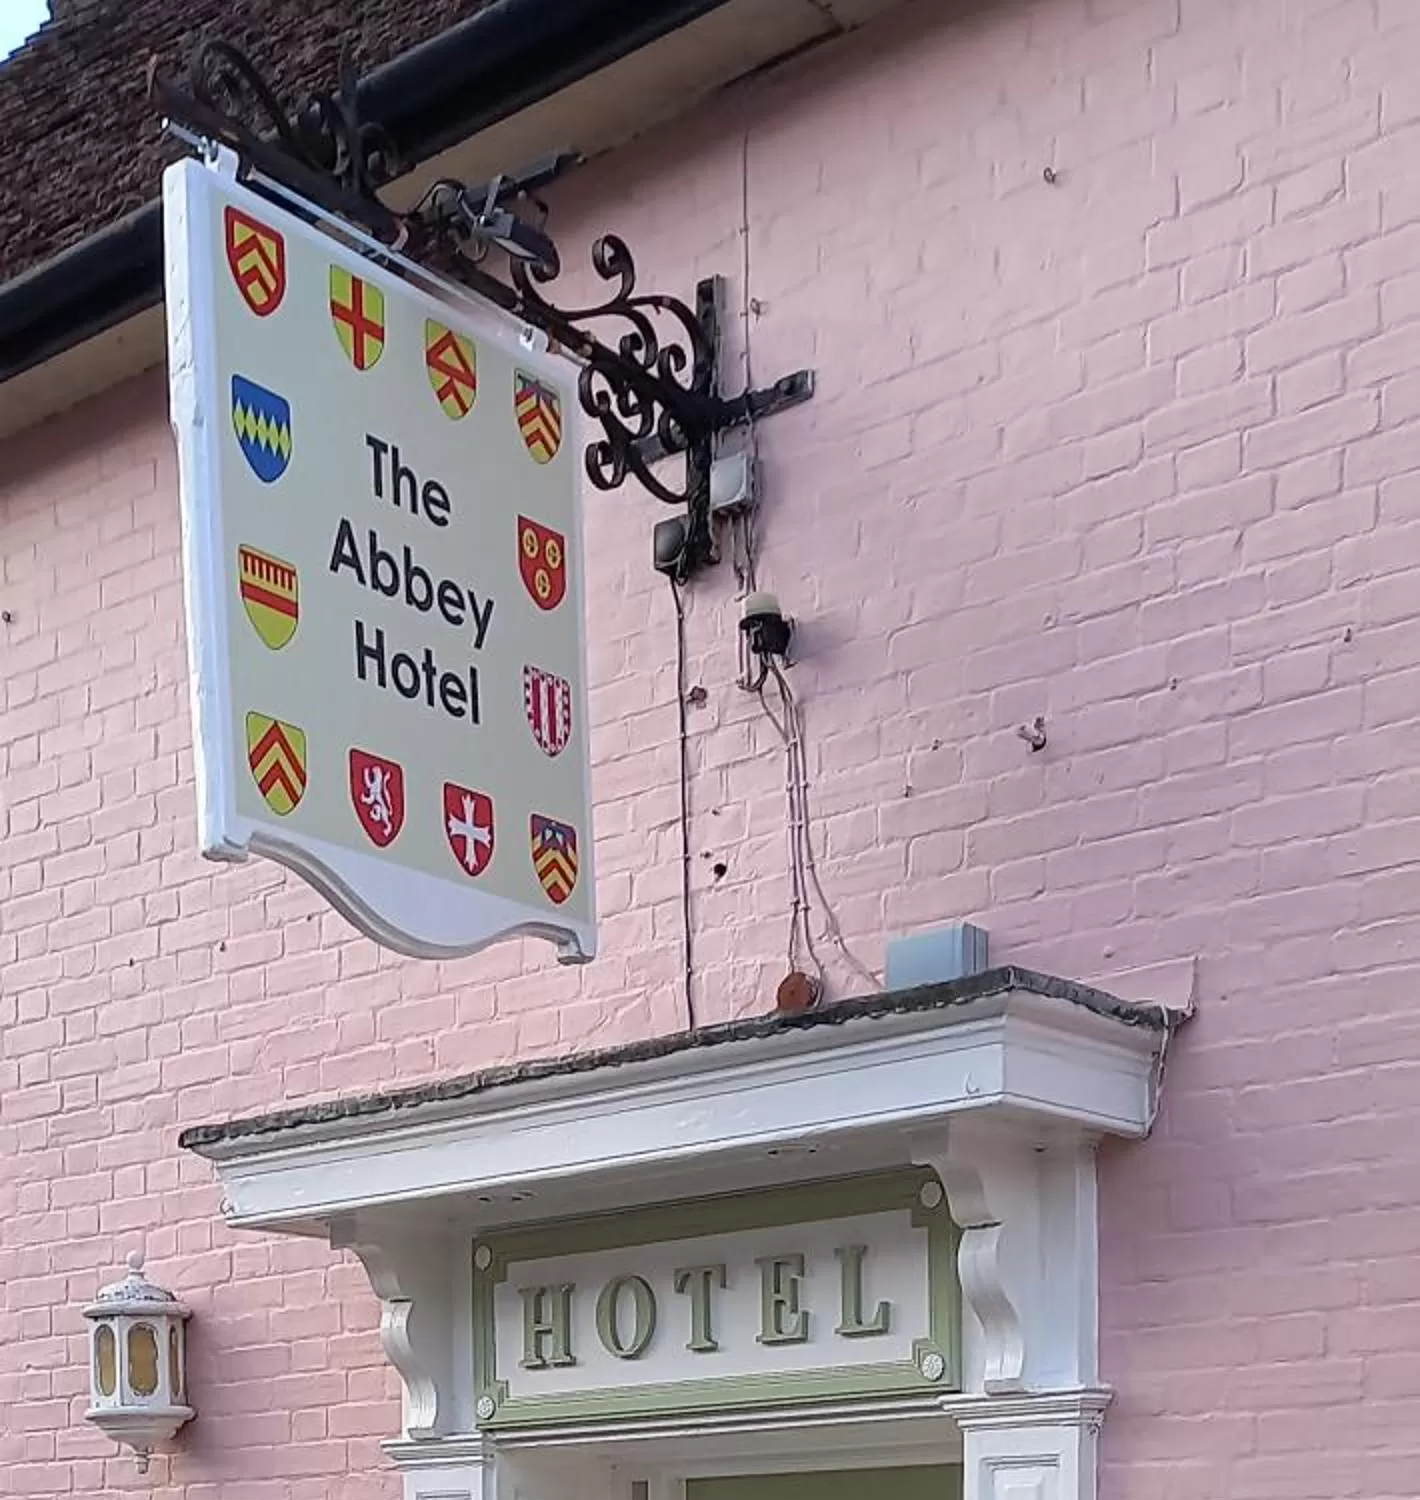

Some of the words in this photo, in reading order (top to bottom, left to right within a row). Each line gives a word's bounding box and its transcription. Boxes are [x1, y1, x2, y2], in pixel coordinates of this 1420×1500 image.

[365, 433, 452, 527] The
[329, 517, 494, 649] Abbey
[355, 620, 480, 724] Hotel
[518, 1244, 891, 1369] HOTEL
